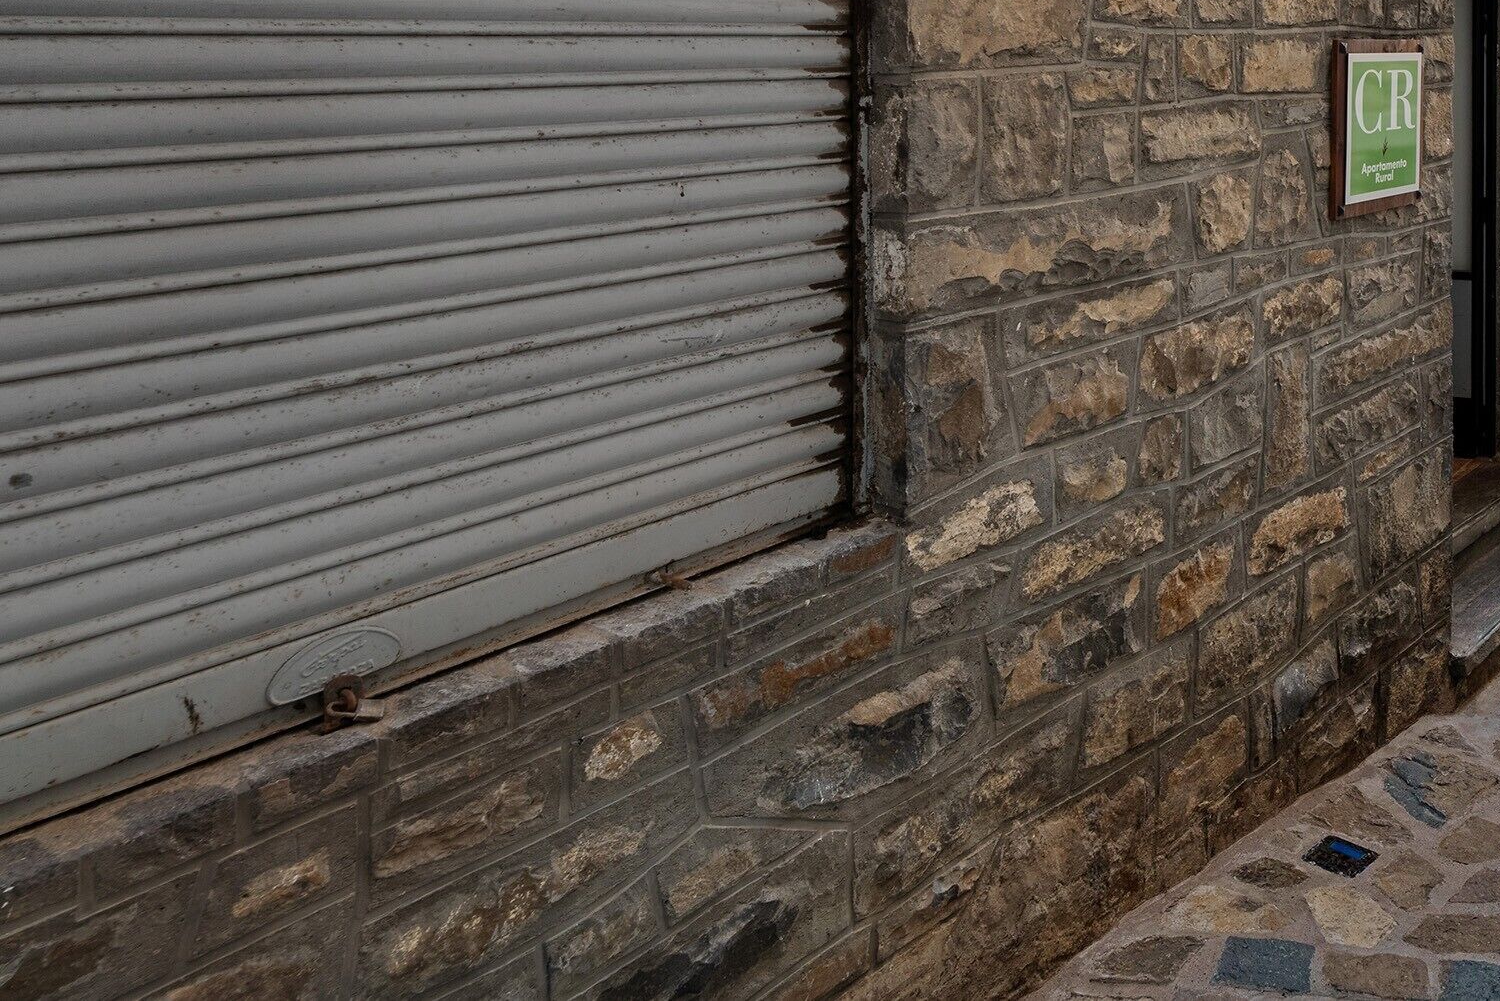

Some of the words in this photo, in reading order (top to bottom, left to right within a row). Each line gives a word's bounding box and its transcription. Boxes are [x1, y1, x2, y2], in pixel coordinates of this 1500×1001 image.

[1355, 69, 1416, 135] CR
[1361, 159, 1408, 177] Apartamento
[1375, 169, 1394, 184] Rural
